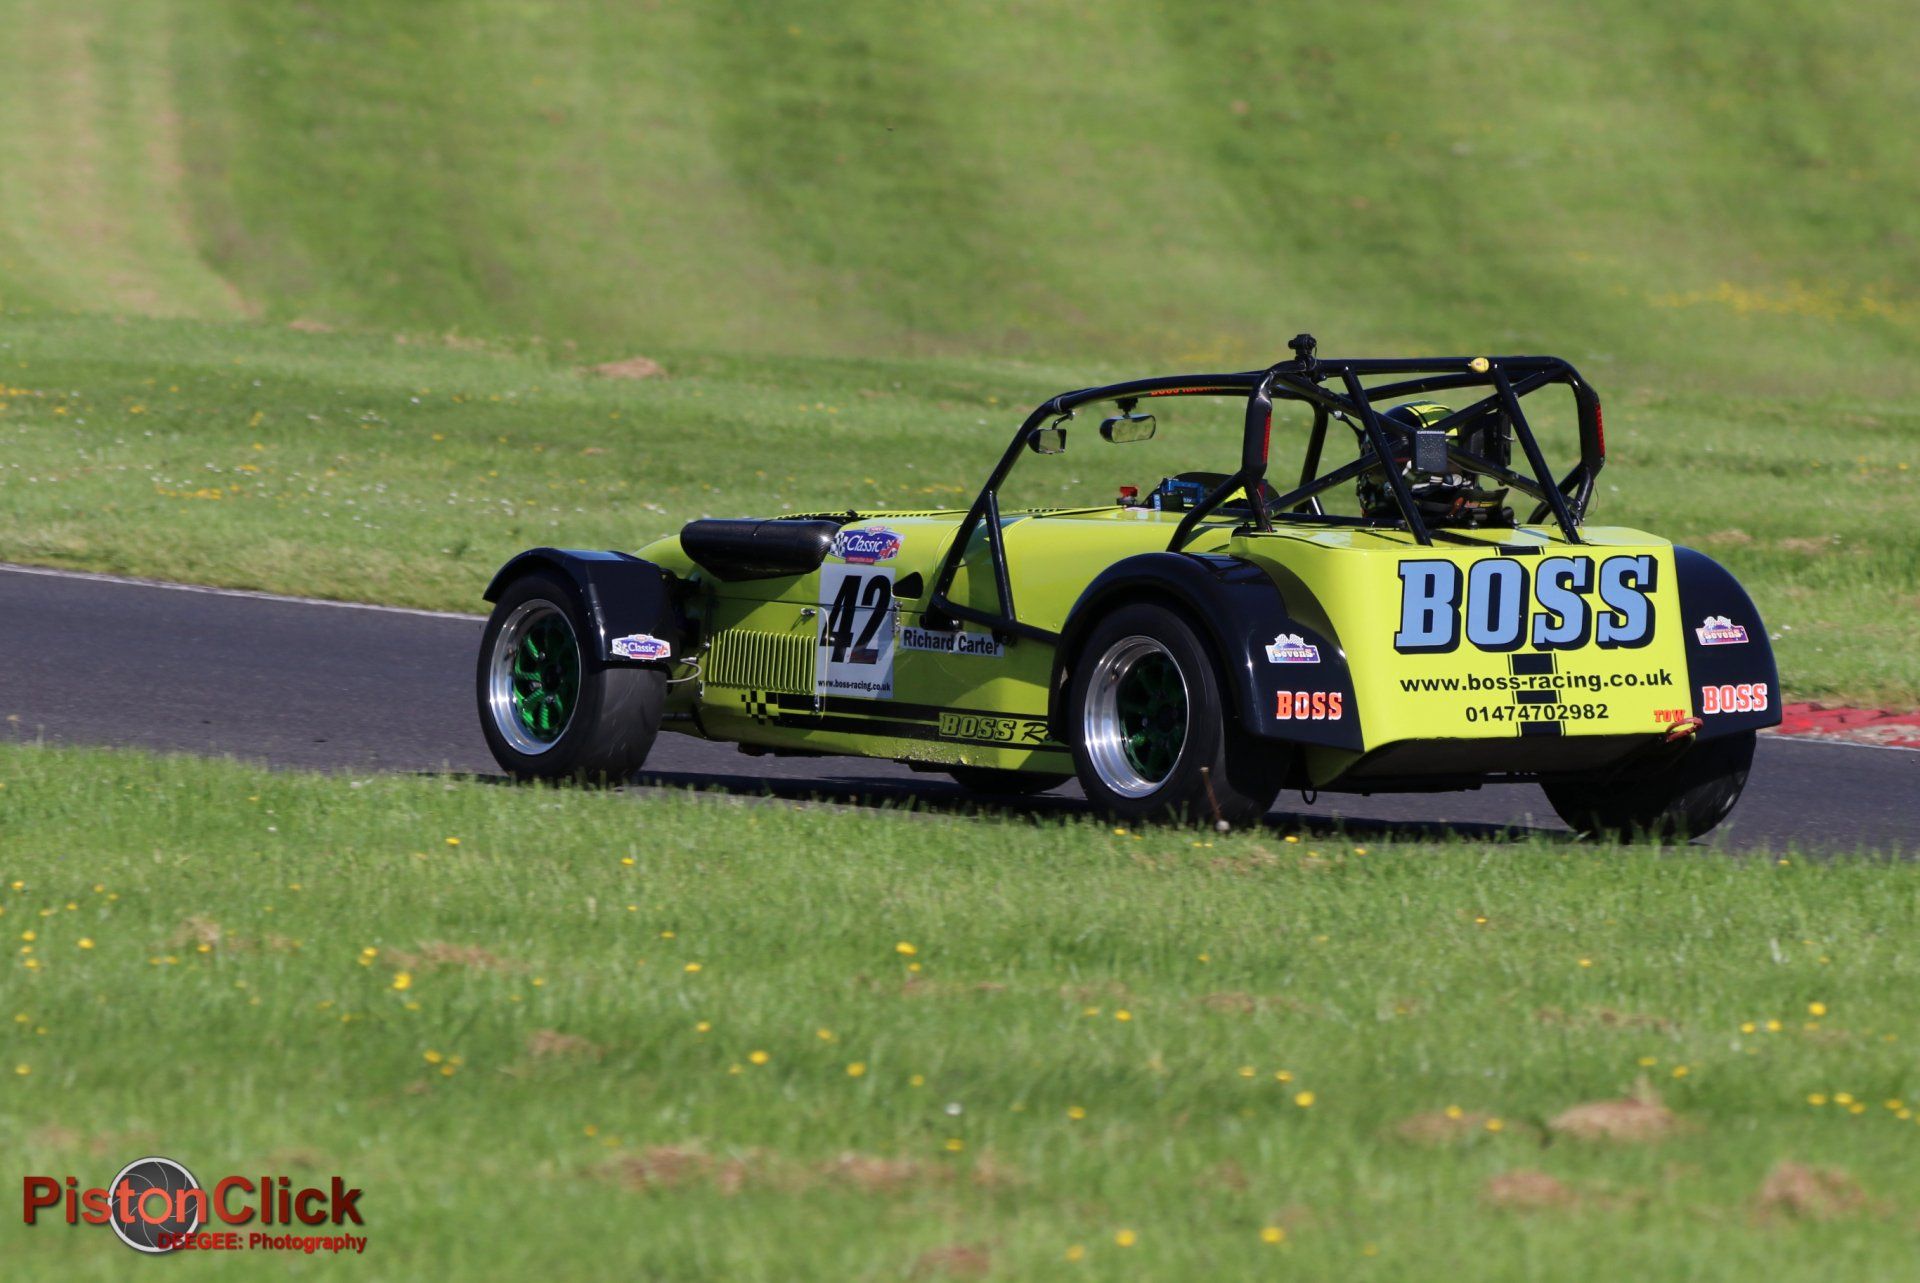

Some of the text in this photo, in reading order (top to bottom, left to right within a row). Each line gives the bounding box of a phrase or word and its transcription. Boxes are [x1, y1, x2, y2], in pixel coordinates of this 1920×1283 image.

[846, 534, 883, 553] Classic
[1394, 555, 1658, 655] BOSS
[819, 575, 891, 664] 42
[627, 642, 656, 653] Classic
[903, 629, 999, 656] Richard Carter
[817, 679, 891, 692] www.boss-racing.co.uk
[1400, 669, 1673, 692] www.boss-racing.co.uk
[1276, 691, 1342, 720] BOSS
[1702, 683, 1768, 714] BOSS
[1465, 704, 1609, 722] 01474702982
[1654, 709, 1685, 723] TOW
[940, 714, 1017, 741] BOSS
